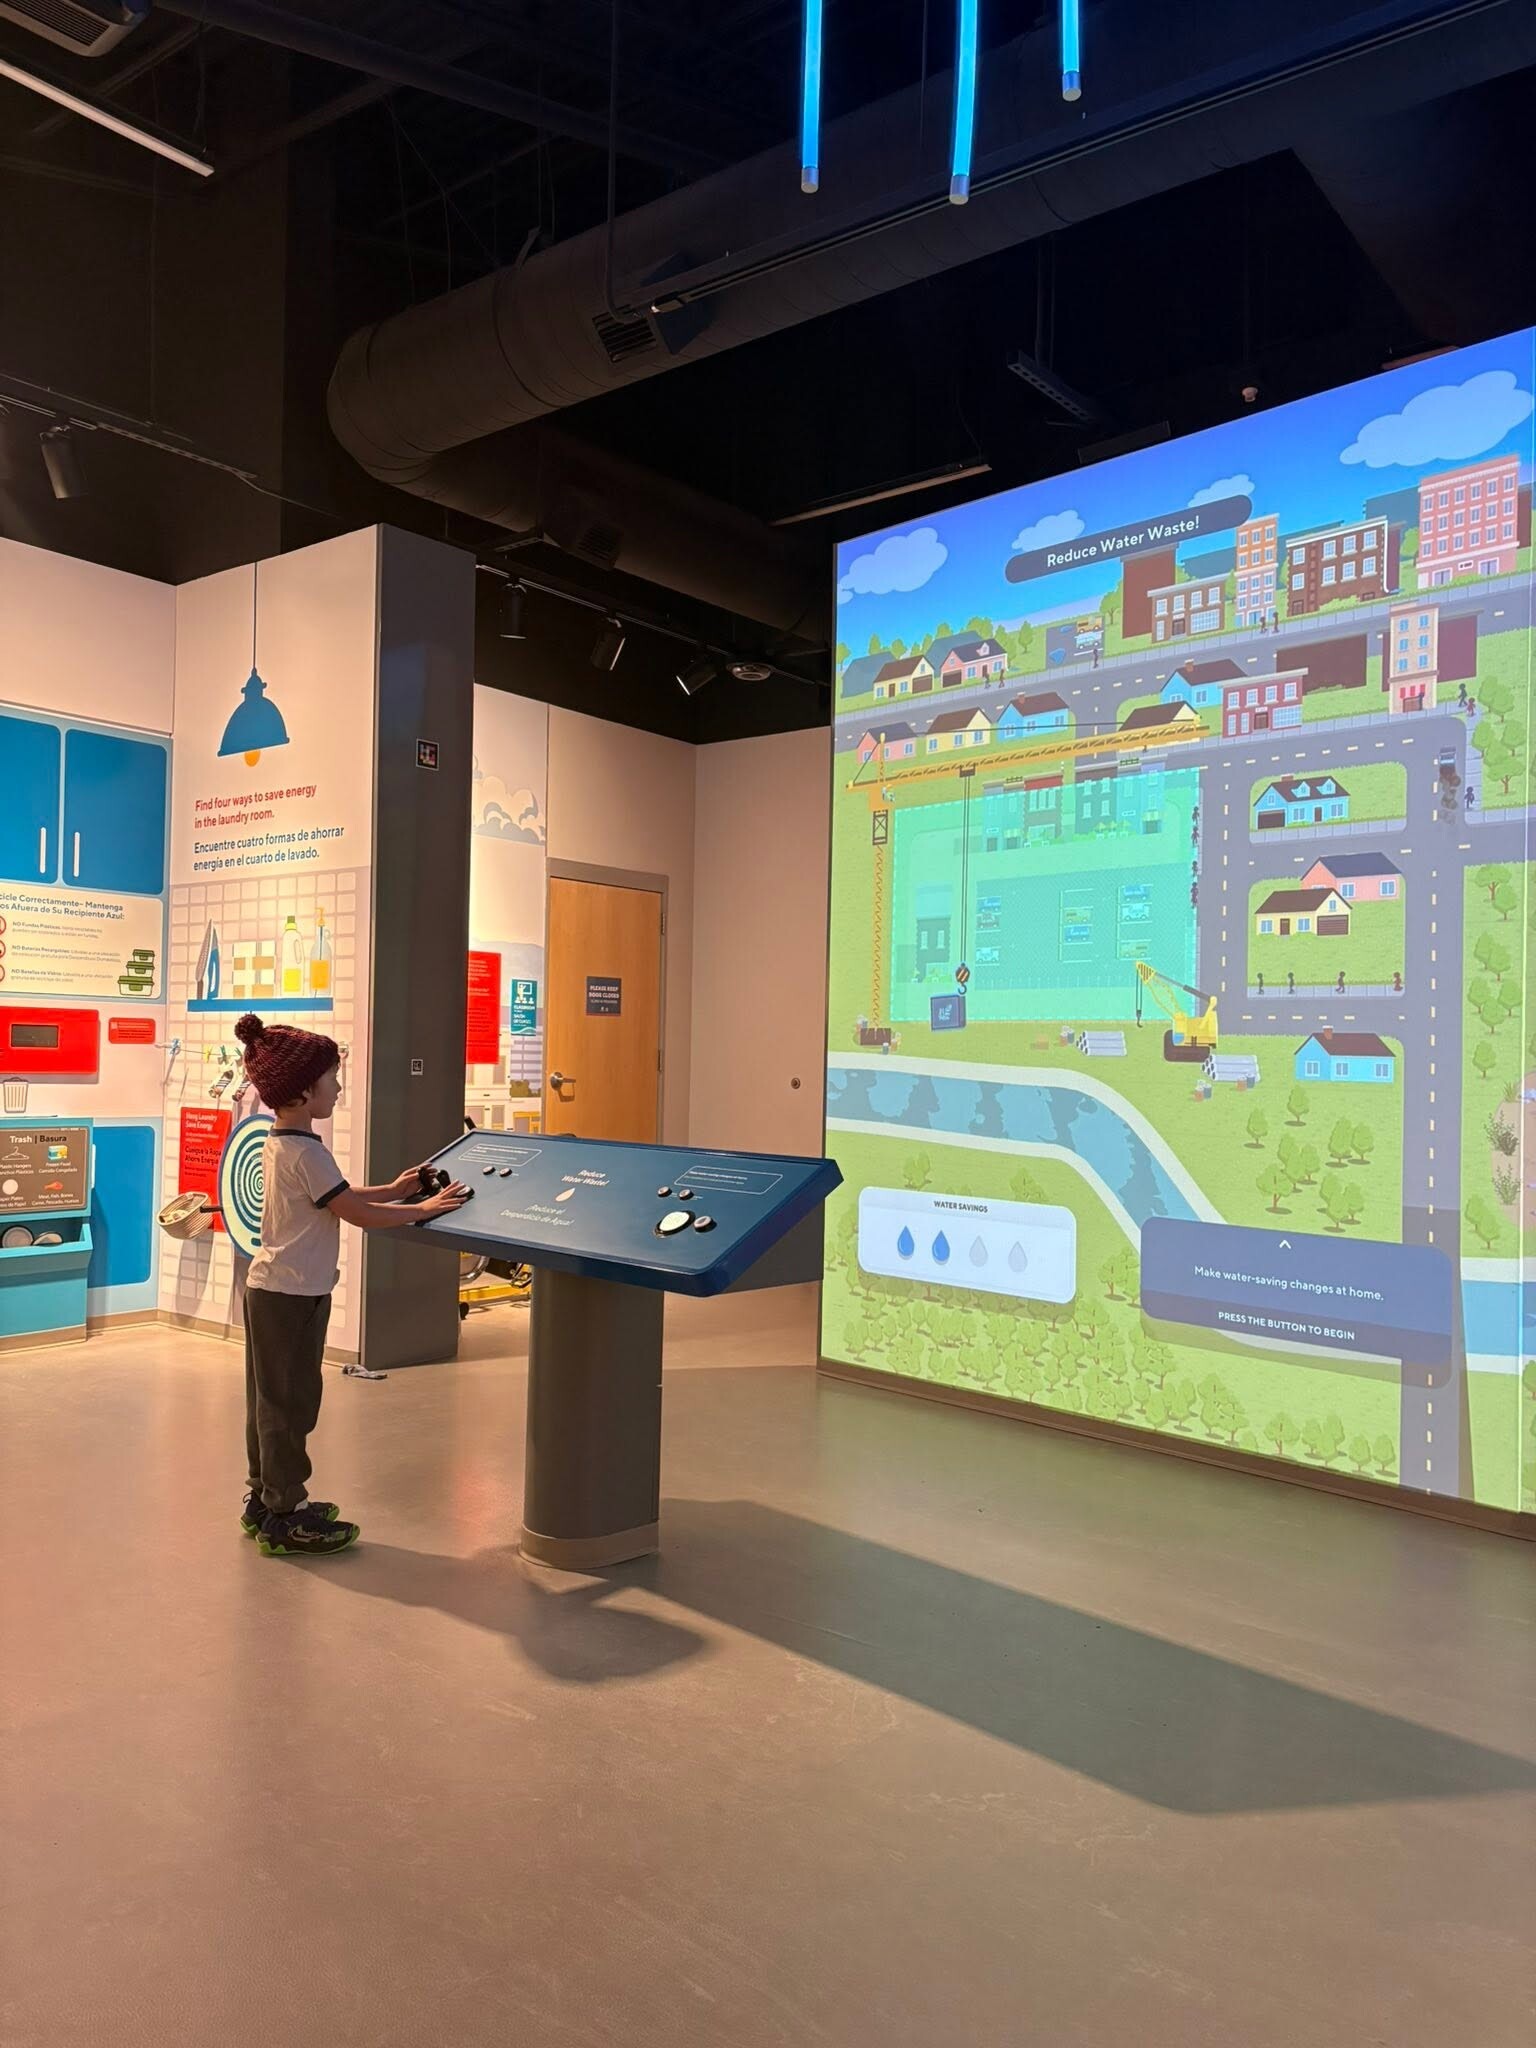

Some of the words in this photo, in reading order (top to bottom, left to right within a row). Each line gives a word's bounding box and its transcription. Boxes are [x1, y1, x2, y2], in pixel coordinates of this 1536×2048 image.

[1047, 545, 1097, 567] Reduce
[1100, 533, 1144, 552] Water
[1147, 515, 1200, 541] Waste!
[195, 799, 213, 811] Find
[214, 796, 231, 809] four
[232, 793, 253, 808] ways
[254, 792, 263, 803] to
[264, 790, 284, 800] save
[285, 784, 317, 798] energy
[194, 817, 203, 829] in
[203, 815, 217, 827] the
[218, 811, 249, 826] laundry
[250, 809, 275, 821] room.
[194, 840, 236, 854] Encuentre
[237, 835, 264, 848] cuatro
[265, 832, 296, 845] formas
[297, 829, 309, 841] de
[310, 826, 345, 840] ahorrar
[224, 858, 235, 868] en
[236, 855, 245, 866] el
[245, 852, 273, 865] cuarto
[274, 850, 286, 862] de
[287, 847, 320, 861] lavado.
[11, 903, 38, 912] Afuera
[52, 906, 62, 914] Su
[64, 907, 104, 918] Recipiente
[85, 901, 123, 912] Mantenga
[9, 1135, 32, 1143] Trash
[39, 1135, 67, 1143] Basura
[561, 1174, 583, 1184] Water
[577, 1169, 606, 1179] Reduce
[933, 1200, 958, 1210] WATER
[958, 1203, 988, 1213] SAVINGS
[1194, 1265, 1221, 1280] Make
[1223, 1270, 1288, 1290] water-saving
[1289, 1279, 1334, 1295] changes
[1335, 1286, 1347, 1296] at
[1349, 1286, 1384, 1301] home.
[1218, 1311, 1246, 1324] PRESS
[1247, 1316, 1266, 1327] THE
[1267, 1318, 1306, 1333] BUTTON
[1307, 1324, 1322, 1335] TO
[1323, 1327, 1355, 1340] BEGIN
